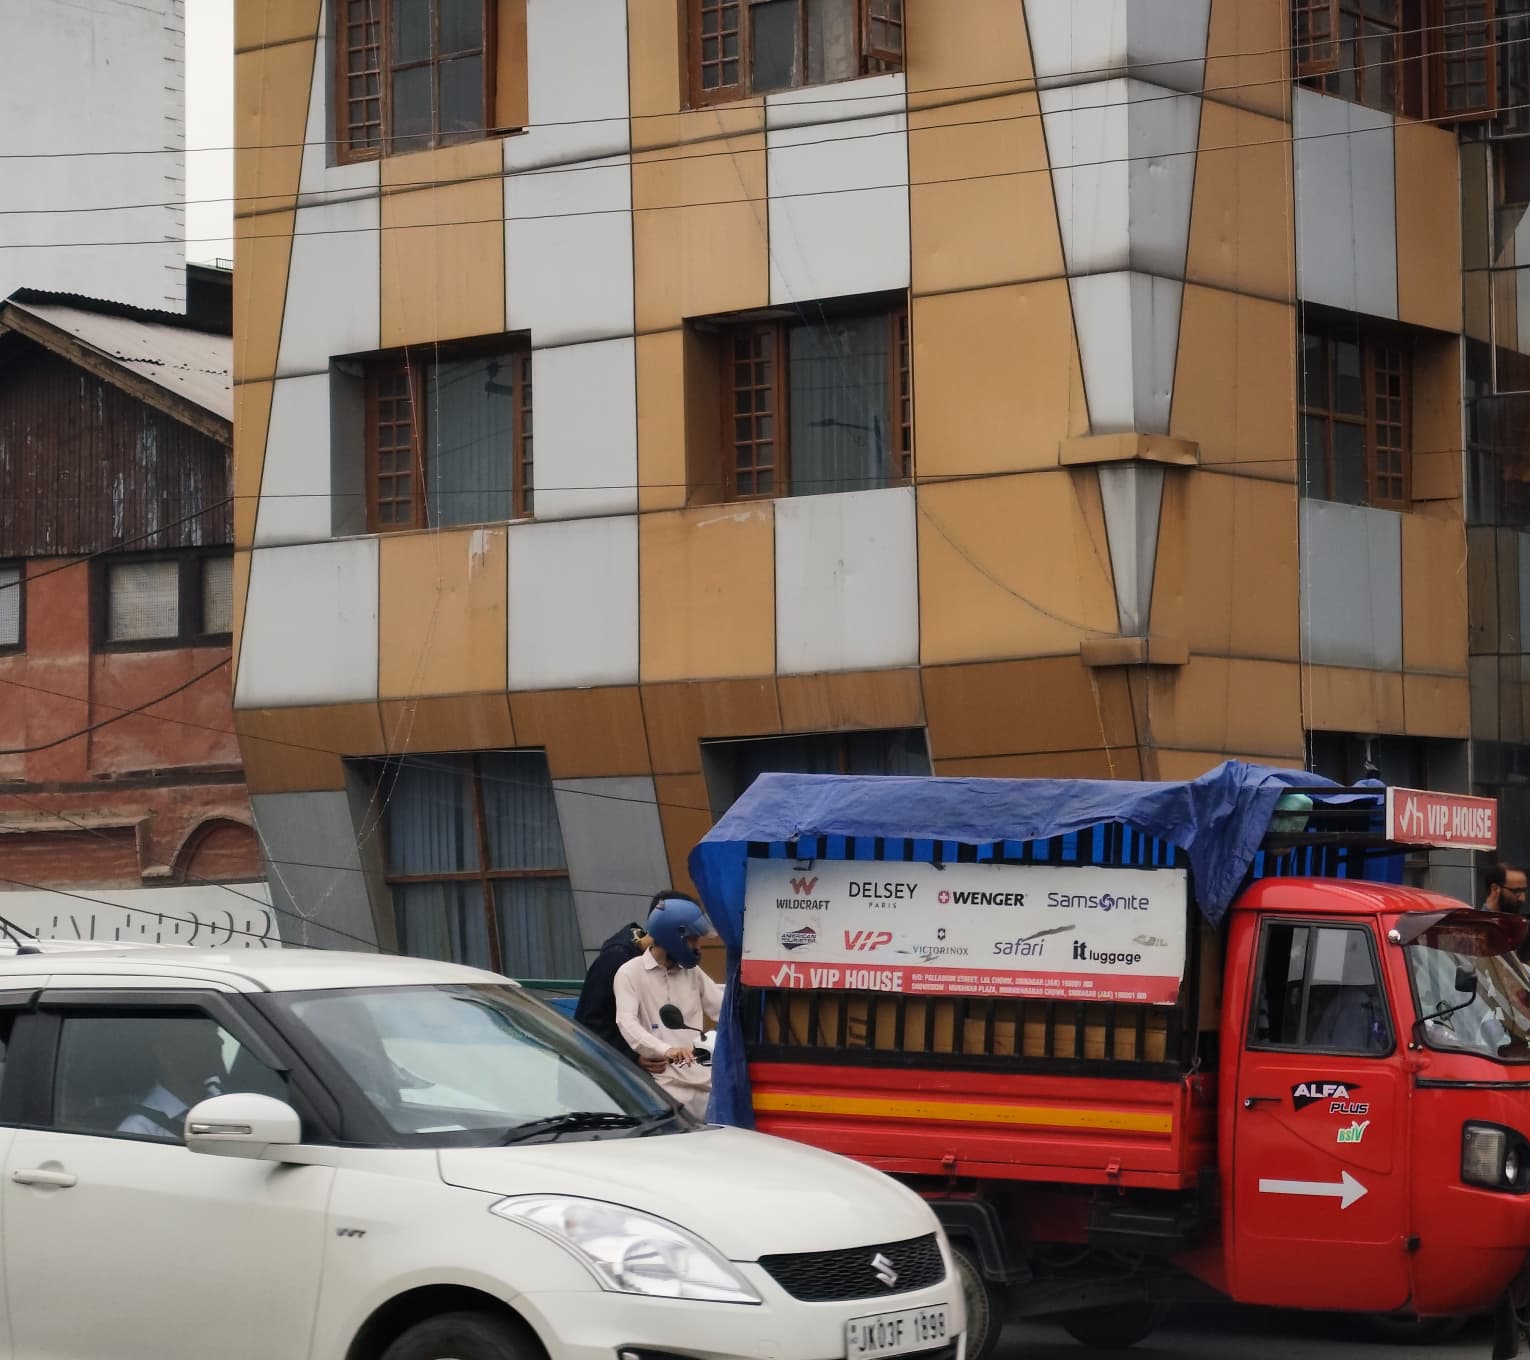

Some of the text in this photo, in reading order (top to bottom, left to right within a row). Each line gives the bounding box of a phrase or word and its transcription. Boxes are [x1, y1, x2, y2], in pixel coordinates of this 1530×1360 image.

[1427, 804, 1492, 839] VIP HOUSE
[848, 881, 918, 899] DELSEY
[952, 891, 1025, 907] WENGER
[776, 898, 831, 911] WILDCRAFT
[1047, 892, 1150, 912] Samsonite
[843, 930, 893, 951] VIP
[992, 938, 1045, 957] safari
[912, 945, 969, 956] VICTORINOX
[1072, 940, 1142, 965] it luggage
[809, 967, 903, 992] VIP HOUSE
[1293, 1083, 1350, 1099] ALFA
[1329, 1101, 1369, 1115] PLUS
